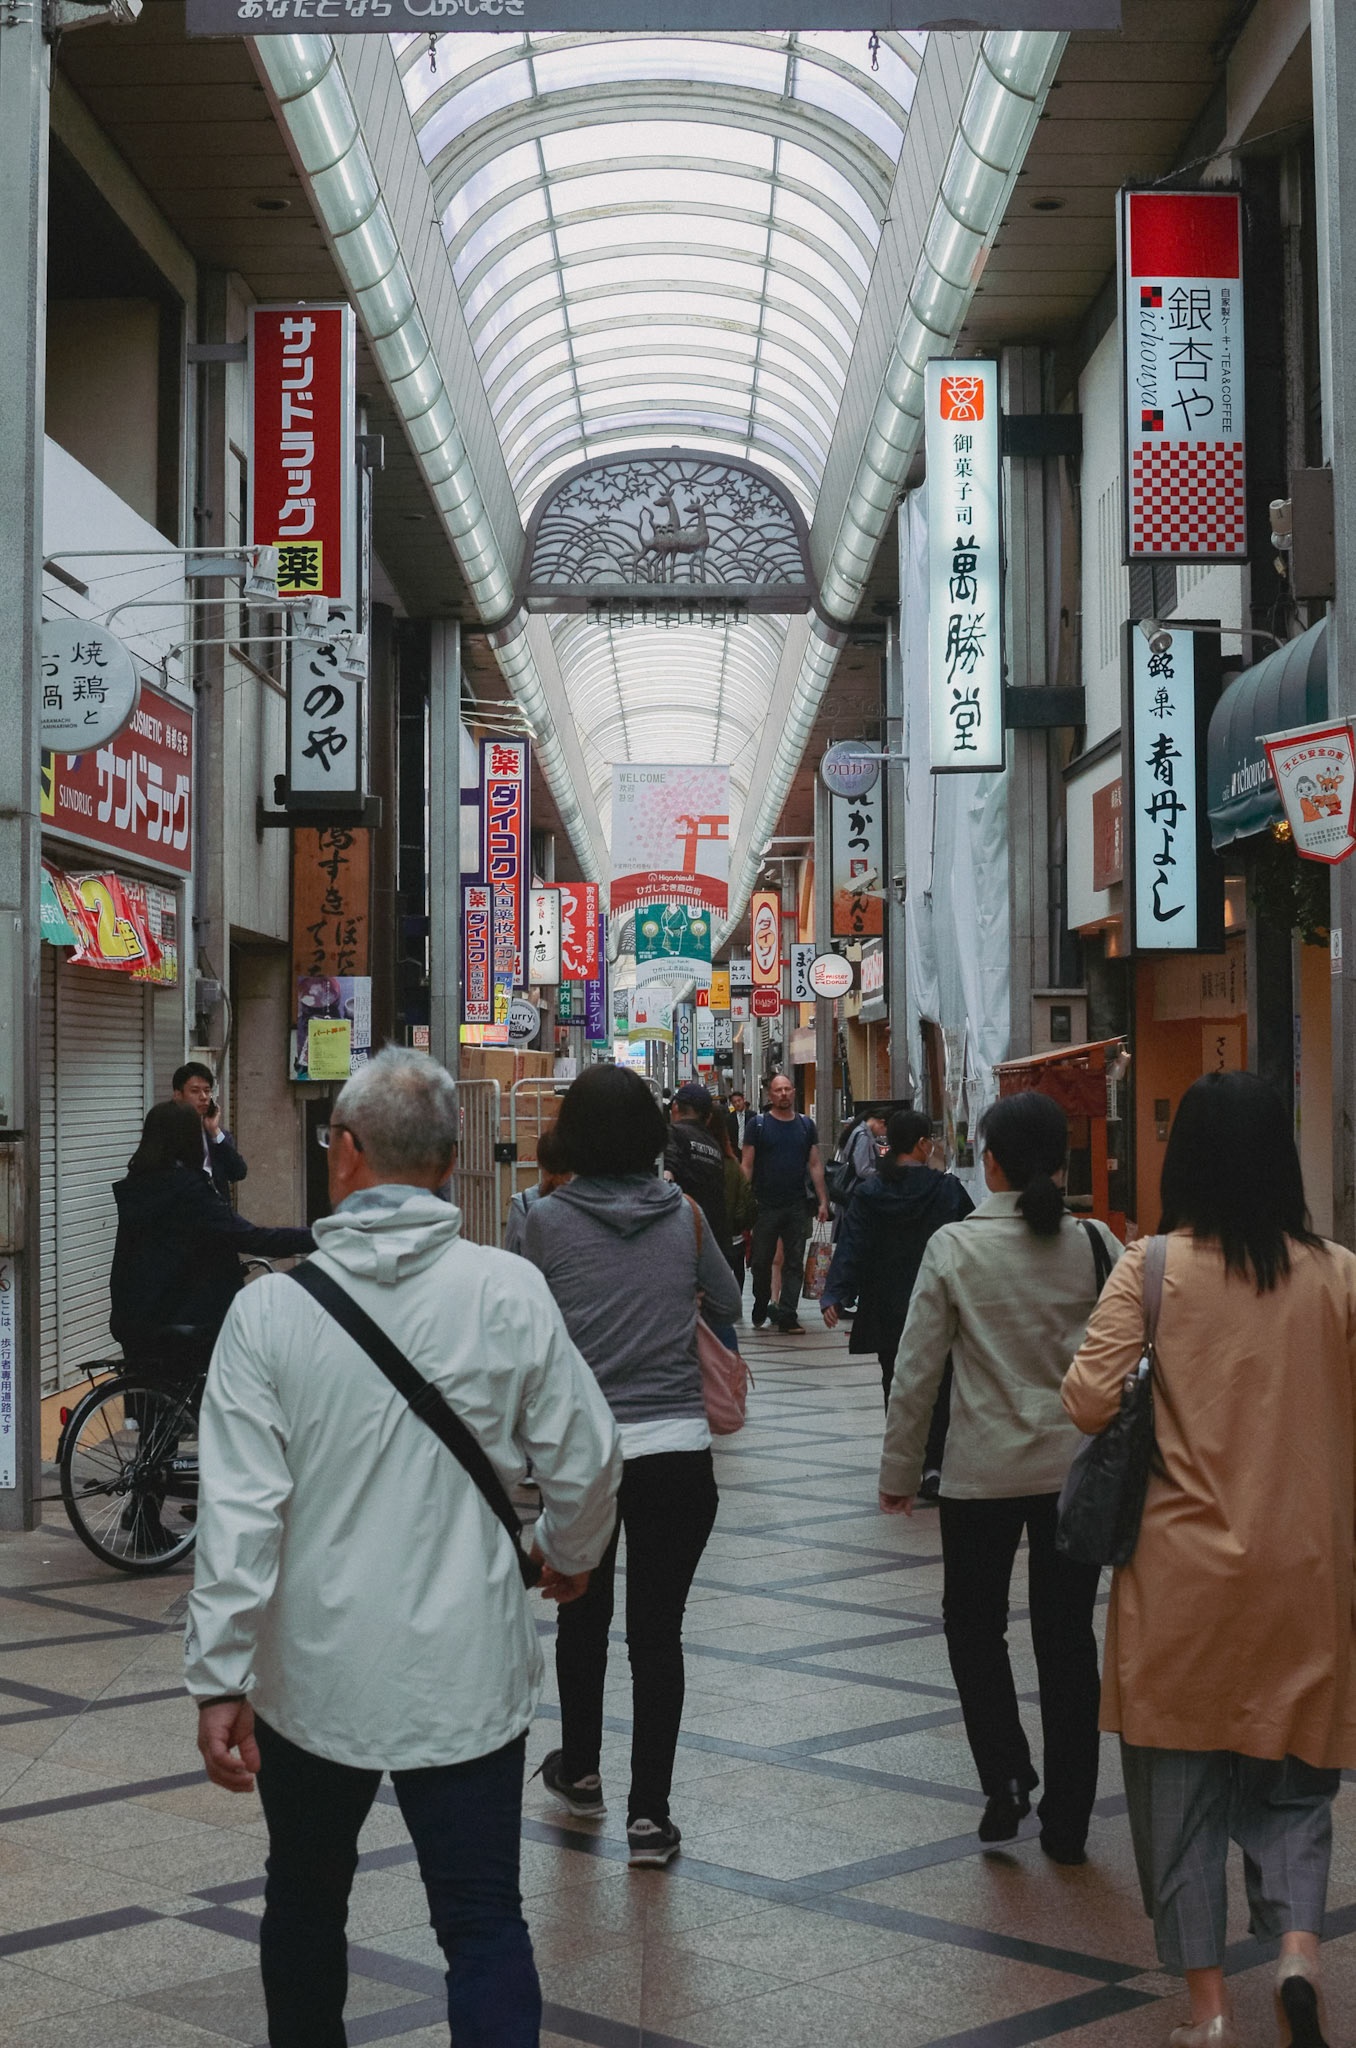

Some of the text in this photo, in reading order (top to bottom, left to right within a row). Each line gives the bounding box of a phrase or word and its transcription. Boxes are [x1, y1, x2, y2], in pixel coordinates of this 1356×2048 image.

[1136, 310, 1165, 407] ichouya
[1167, 286, 1214, 432] 銀杏や
[276, 316, 320, 589] サンドラッグ 薬
[952, 433, 974, 526] 御菓子司
[945, 535, 986, 751] 萬勝堂
[70, 641, 109, 725] 焼鶏と
[491, 744, 519, 776] 薬
[619, 773, 666, 783] WELCOME
[826, 763, 875, 776] クロカワ
[1237, 757, 1267, 795] ichouya
[1284, 748, 1345, 771] 子ども安全の家
[59, 784, 93, 817] SUNDRUG
[96, 743, 191, 851] サンドラッグ
[490, 784, 519, 880] ダイコク
[1144, 733, 1187, 922] 青丹よし
[469, 888, 487, 908] 薬
[469, 913, 486, 964] ダイコク
[758, 916, 773, 967] ダイソー
[467, 1003, 490, 1016] 免税
[511, 1013, 533, 1023] urry
